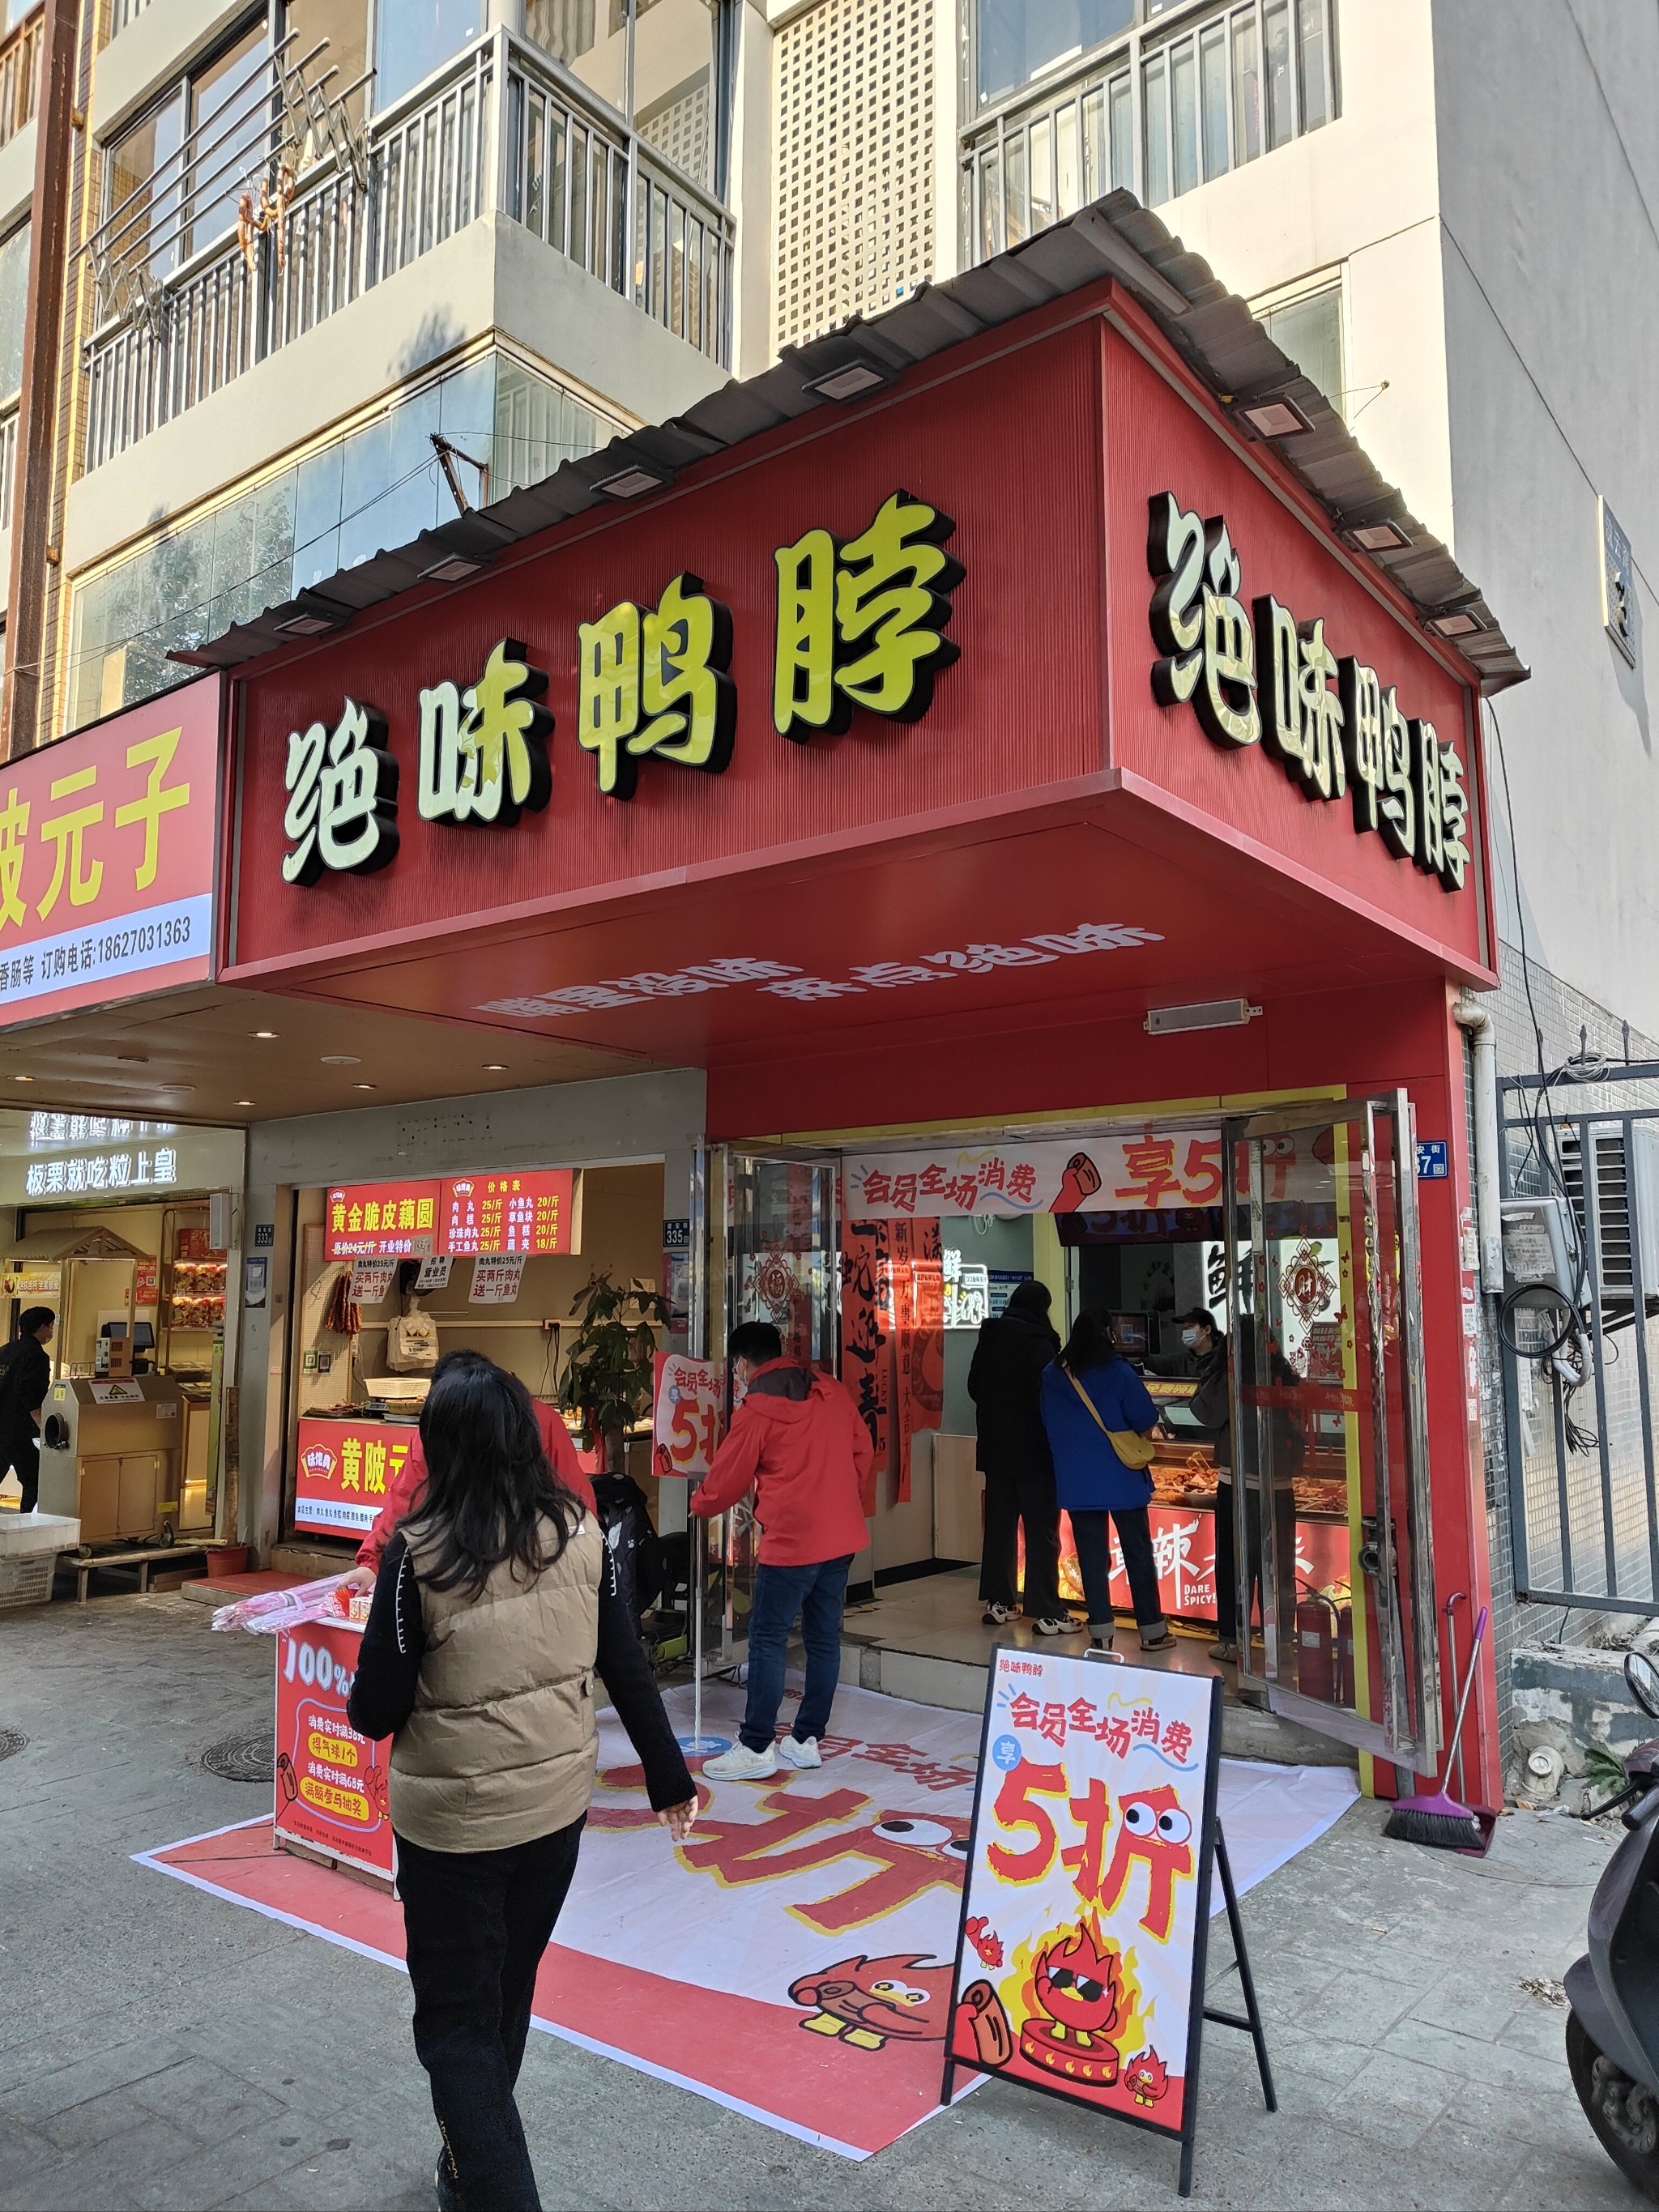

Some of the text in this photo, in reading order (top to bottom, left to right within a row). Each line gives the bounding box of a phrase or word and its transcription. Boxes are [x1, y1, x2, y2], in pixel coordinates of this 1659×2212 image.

[280, 488, 966, 887] 绝味鸭脖
[1146, 490, 1470, 893] 绝味鸭脖
[41, 915, 191, 981] 订购电话:18627031363
[755, 922, 1167, 1003] 来点绝味
[1416, 1144, 1440, 1155] 安街
[25, 1147, 177, 1196] 板栗就吃粒上皇
[488, 1179, 521, 1194] 价格表
[862, 1157, 1037, 1213] 会员全场消费
[481, 1199, 503, 1211] 25/斤
[509, 1195, 560, 1209] 小鱼丸 20/斤
[331, 1197, 434, 1234] 黄金脆皮藕圆
[481, 1212, 502, 1225] 25/斤
[508, 1209, 559, 1223] 草鱼块 20/斤
[448, 1225, 501, 1239] 珍珠肉丸 25/斤
[535, 1223, 558, 1235] 20/斤
[257, 1233, 268, 1244] 333
[535, 1237, 558, 1250] 18/斤
[666, 1230, 683, 1244] 335
[379, 1238, 412, 1254] 开业特价
[448, 1239, 501, 1253] 手工鱼丸 25/斤
[357, 1259, 395, 1268] 肉丸特价25元/斤
[479, 1255, 523, 1266] 肉丸特价25元/斤
[424, 1266, 447, 1278] 营业员
[476, 1268, 521, 1282] 买两斤肉丸
[472, 1283, 518, 1297] 送一斤鱼丸
[1297, 1272, 1314, 1303] 财
[1184, 1583, 1211, 1596] DARE
[1184, 1596, 1216, 1606] SPICY!
[283, 1637, 356, 1698] 100%
[999, 1659, 1043, 1677] 绝味鸭脖
[1009, 1691, 1193, 1764] 会员全场消费
[312, 1736, 356, 1765] 得气球1个
[996, 1741, 1017, 1767] 享
[307, 1760, 365, 1794] 消费实付满68元
[305, 1780, 362, 1817] 满额参与抽奖
